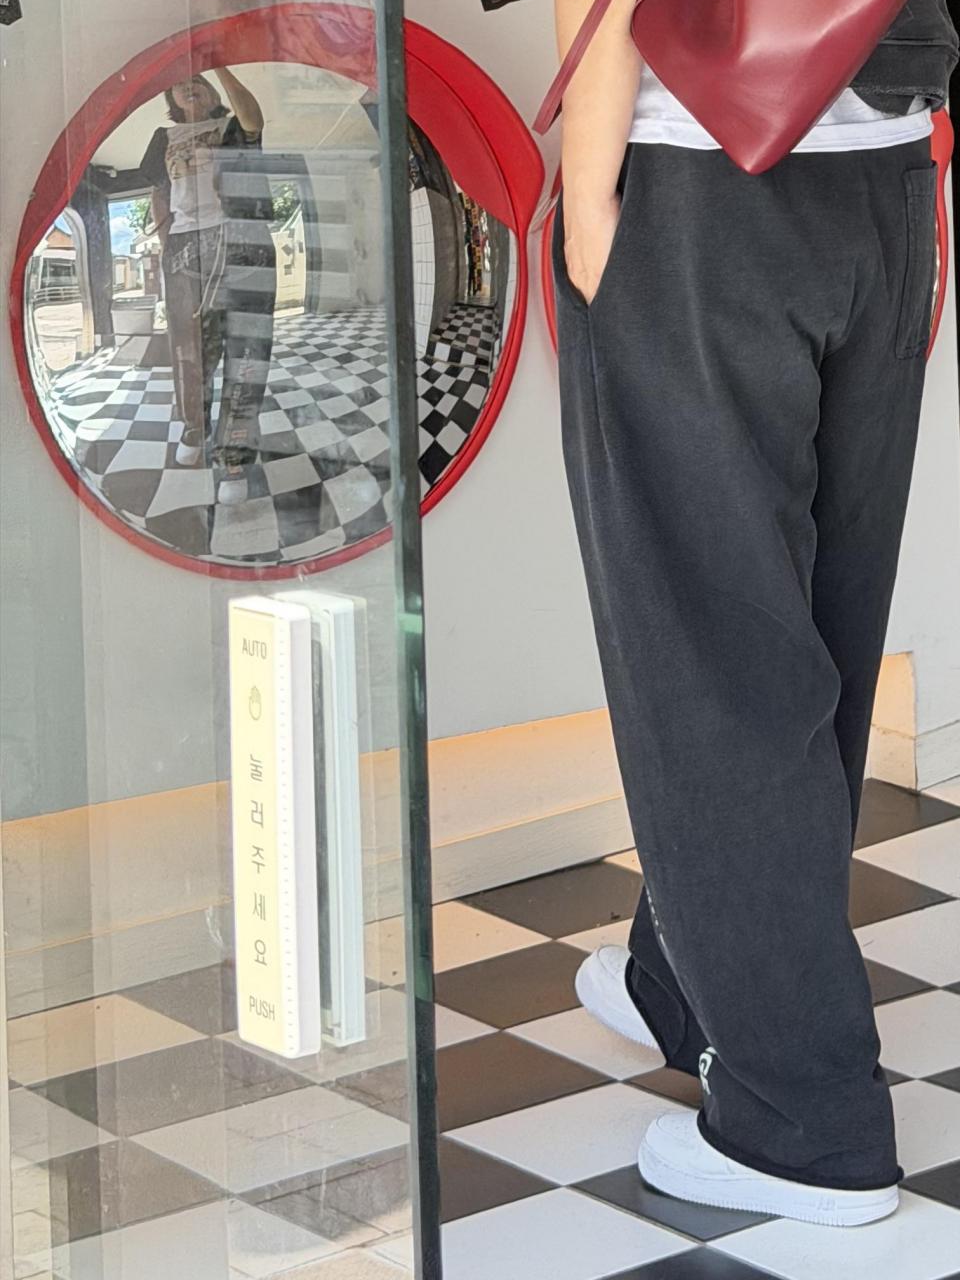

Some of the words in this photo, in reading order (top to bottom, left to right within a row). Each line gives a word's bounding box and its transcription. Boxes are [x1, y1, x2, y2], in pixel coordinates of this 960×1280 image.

[241, 637, 268, 660] AUTO
[249, 753, 268, 967] 눌러주세요
[249, 994, 276, 1021] PUSH
